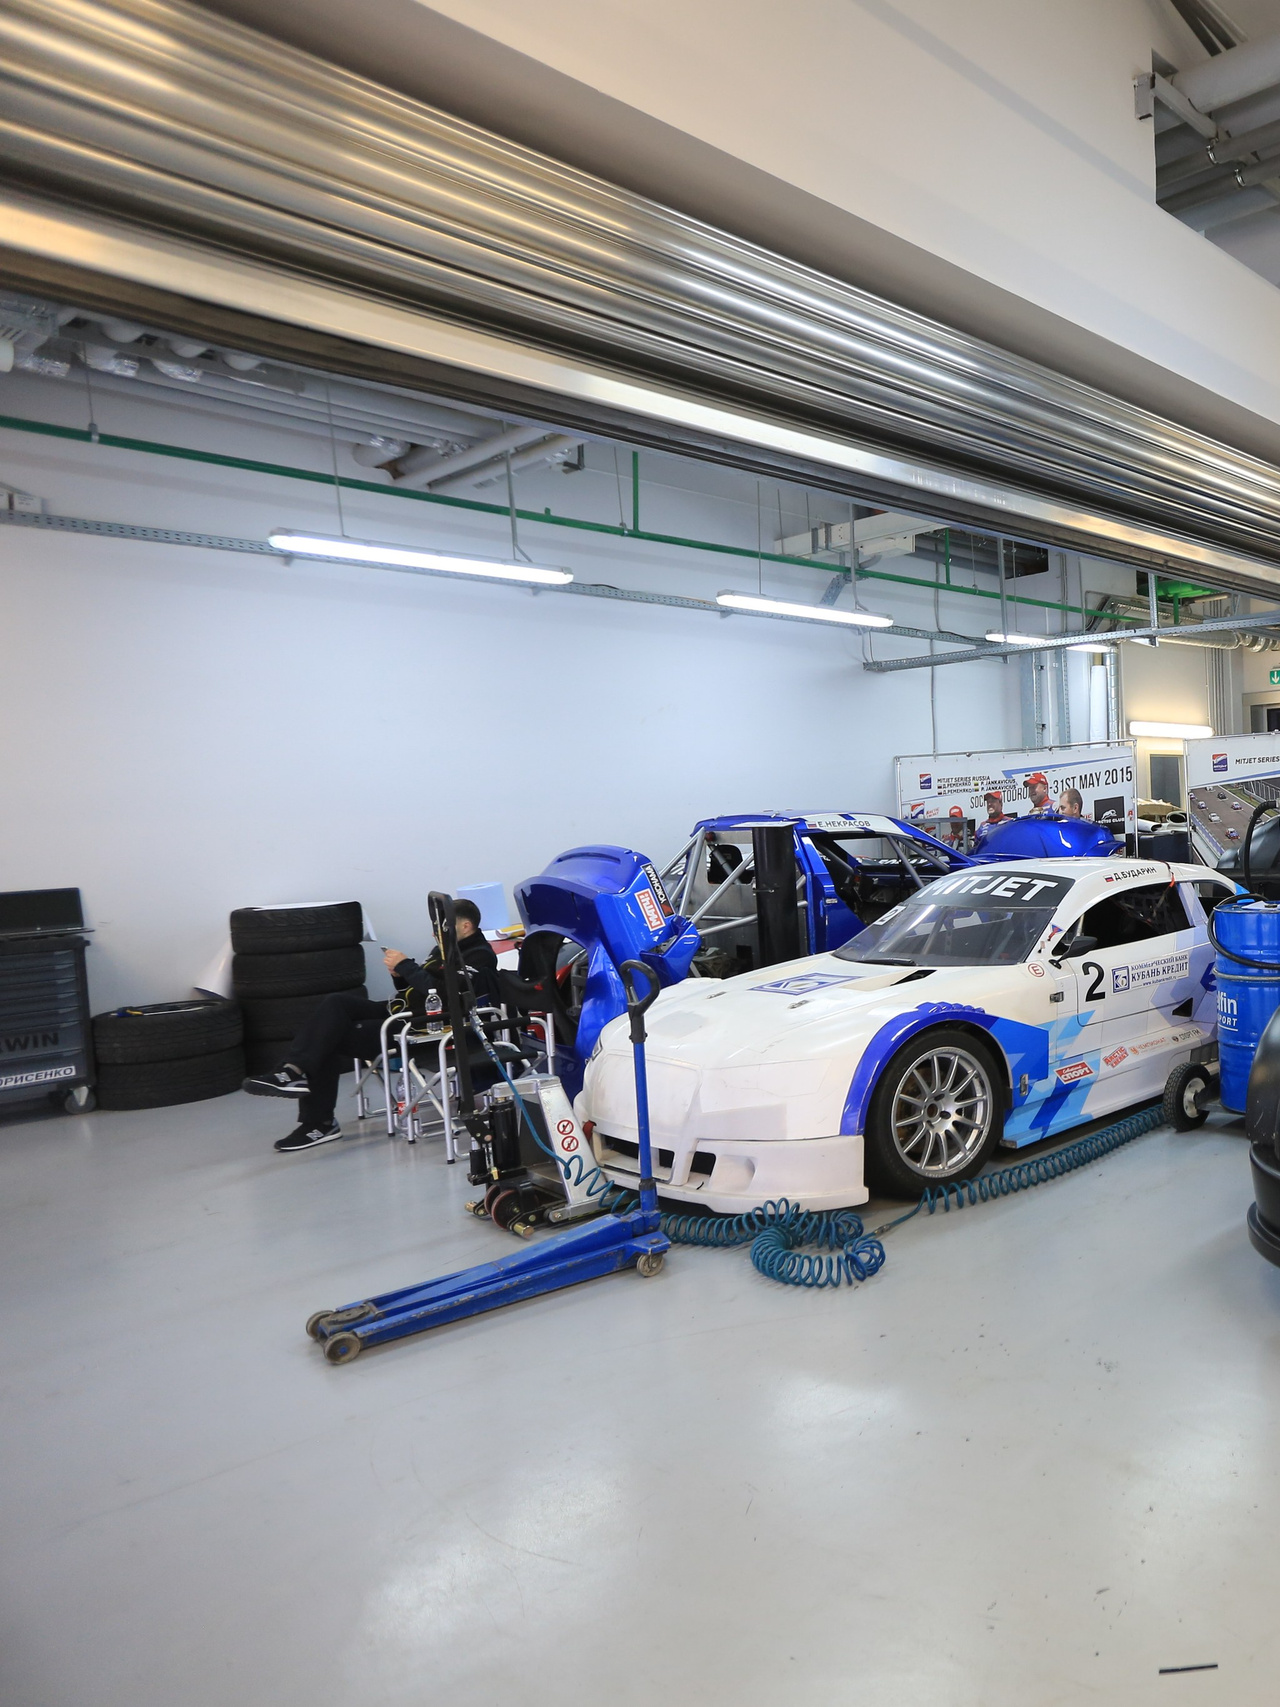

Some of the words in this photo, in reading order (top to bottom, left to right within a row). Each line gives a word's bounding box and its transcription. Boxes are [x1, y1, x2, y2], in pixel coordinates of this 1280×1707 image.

[1080, 771, 1101, 789] MAY
[1104, 766, 1133, 786] 2015
[817, 820, 871, 828] Е.НЕКРАСОВ
[1113, 866, 1158, 881] Д.БУДАРИН
[645, 865, 667, 904] YOKOHAMA
[917, 875, 1058, 901] MITJET
[1131, 956, 1175, 972] КОММЕРЧЕСКИЙ
[1175, 954, 1188, 962] БАНК
[1131, 968, 1161, 982] КУБАНЬ
[1162, 962, 1188, 976] КРЕДИТ
[1082, 962, 1106, 1002] 2
[0, 1032, 59, 1053] WIN
[0, 1067, 73, 1086] РИСЕНКО
[1061, 1067, 1090, 1080] СПОРТ
